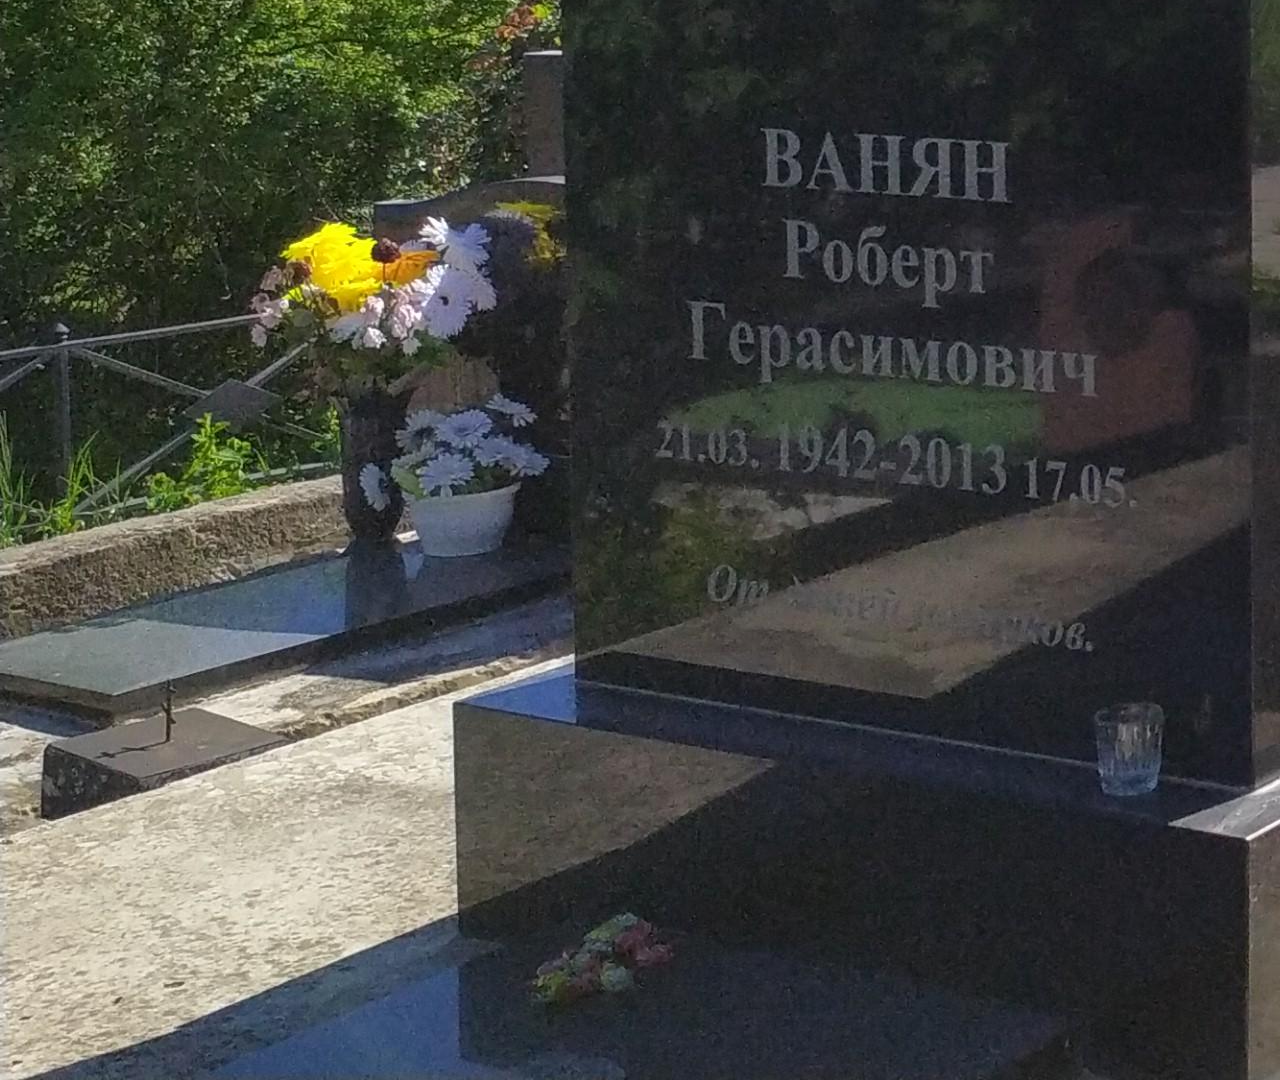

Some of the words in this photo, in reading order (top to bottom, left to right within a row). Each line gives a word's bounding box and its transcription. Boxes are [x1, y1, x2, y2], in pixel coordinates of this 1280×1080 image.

[760, 126, 1013, 204] ВАНЯН
[780, 217, 995, 309] Роберт
[685, 298, 1100, 398] Герасимович
[654, 417, 761, 471] 21.03.
[777, 423, 1008, 496] 1942-2013
[1022, 456, 1138, 509] 17.05.
